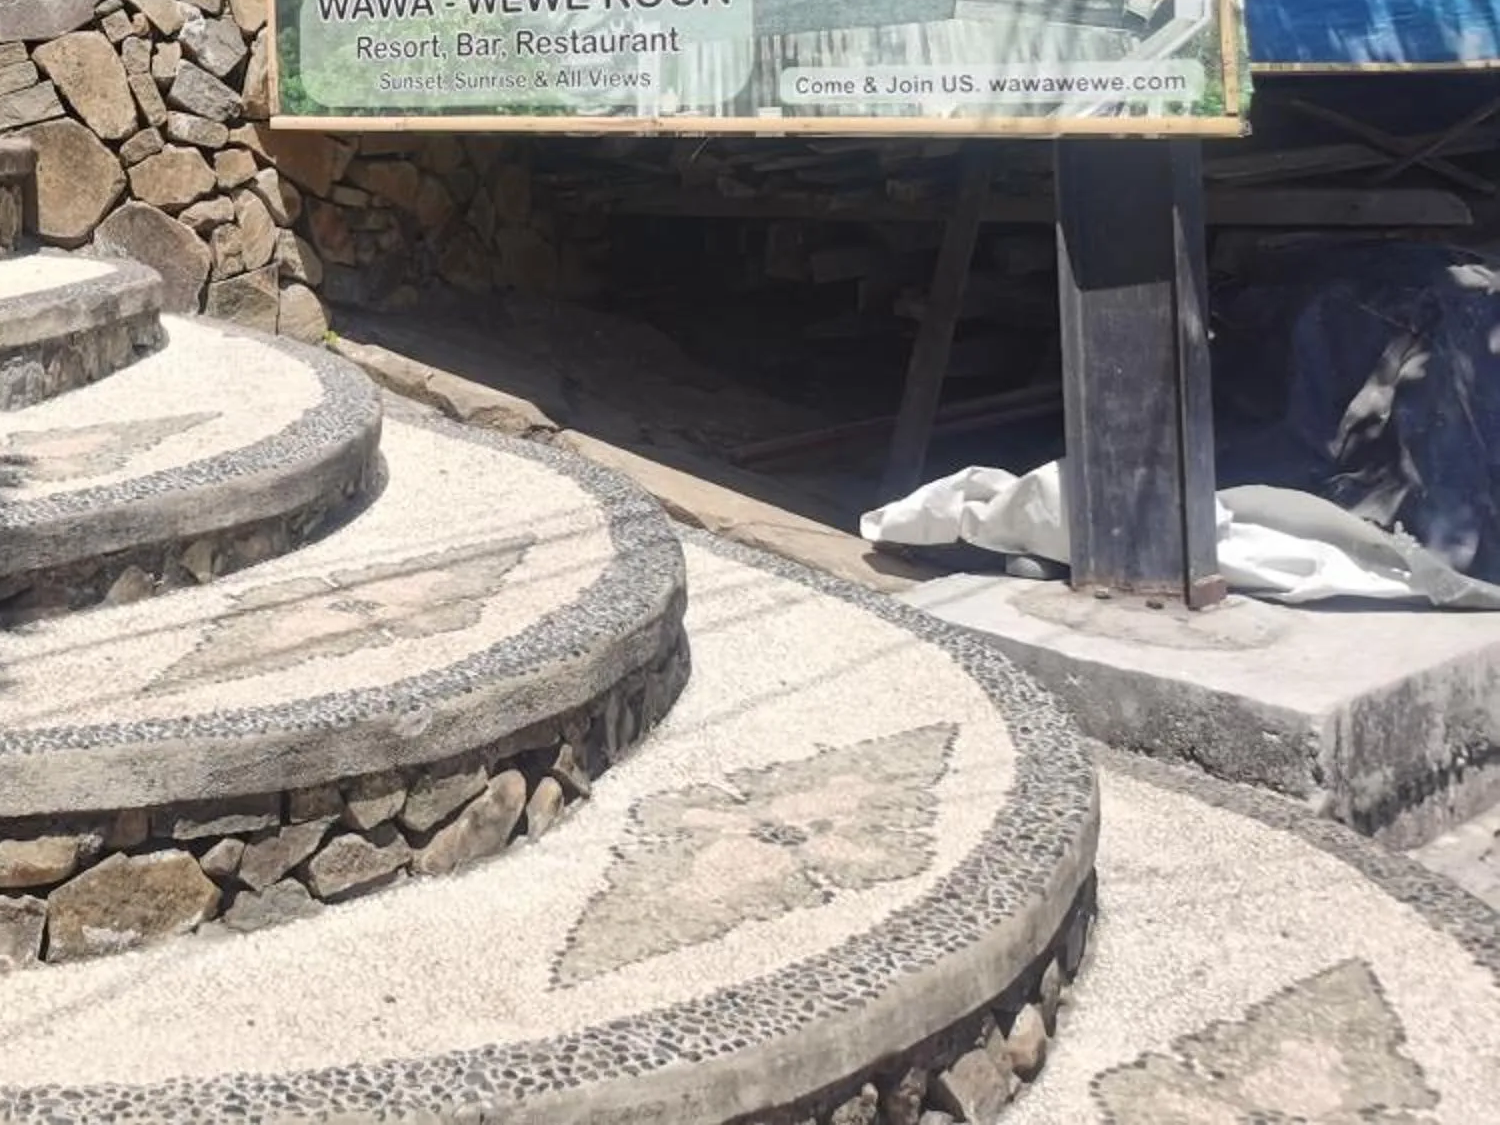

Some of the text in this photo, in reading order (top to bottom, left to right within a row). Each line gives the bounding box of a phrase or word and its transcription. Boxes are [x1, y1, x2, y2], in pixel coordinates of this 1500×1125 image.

[356, 26, 680, 61] Resort, Bar, Restaurant
[454, 72, 527, 90] Sunrise
[534, 70, 549, 88] &
[555, 69, 582, 88] All
[588, 68, 651, 88] Views
[794, 72, 1187, 94] Come & Join US. wawawewe.com
